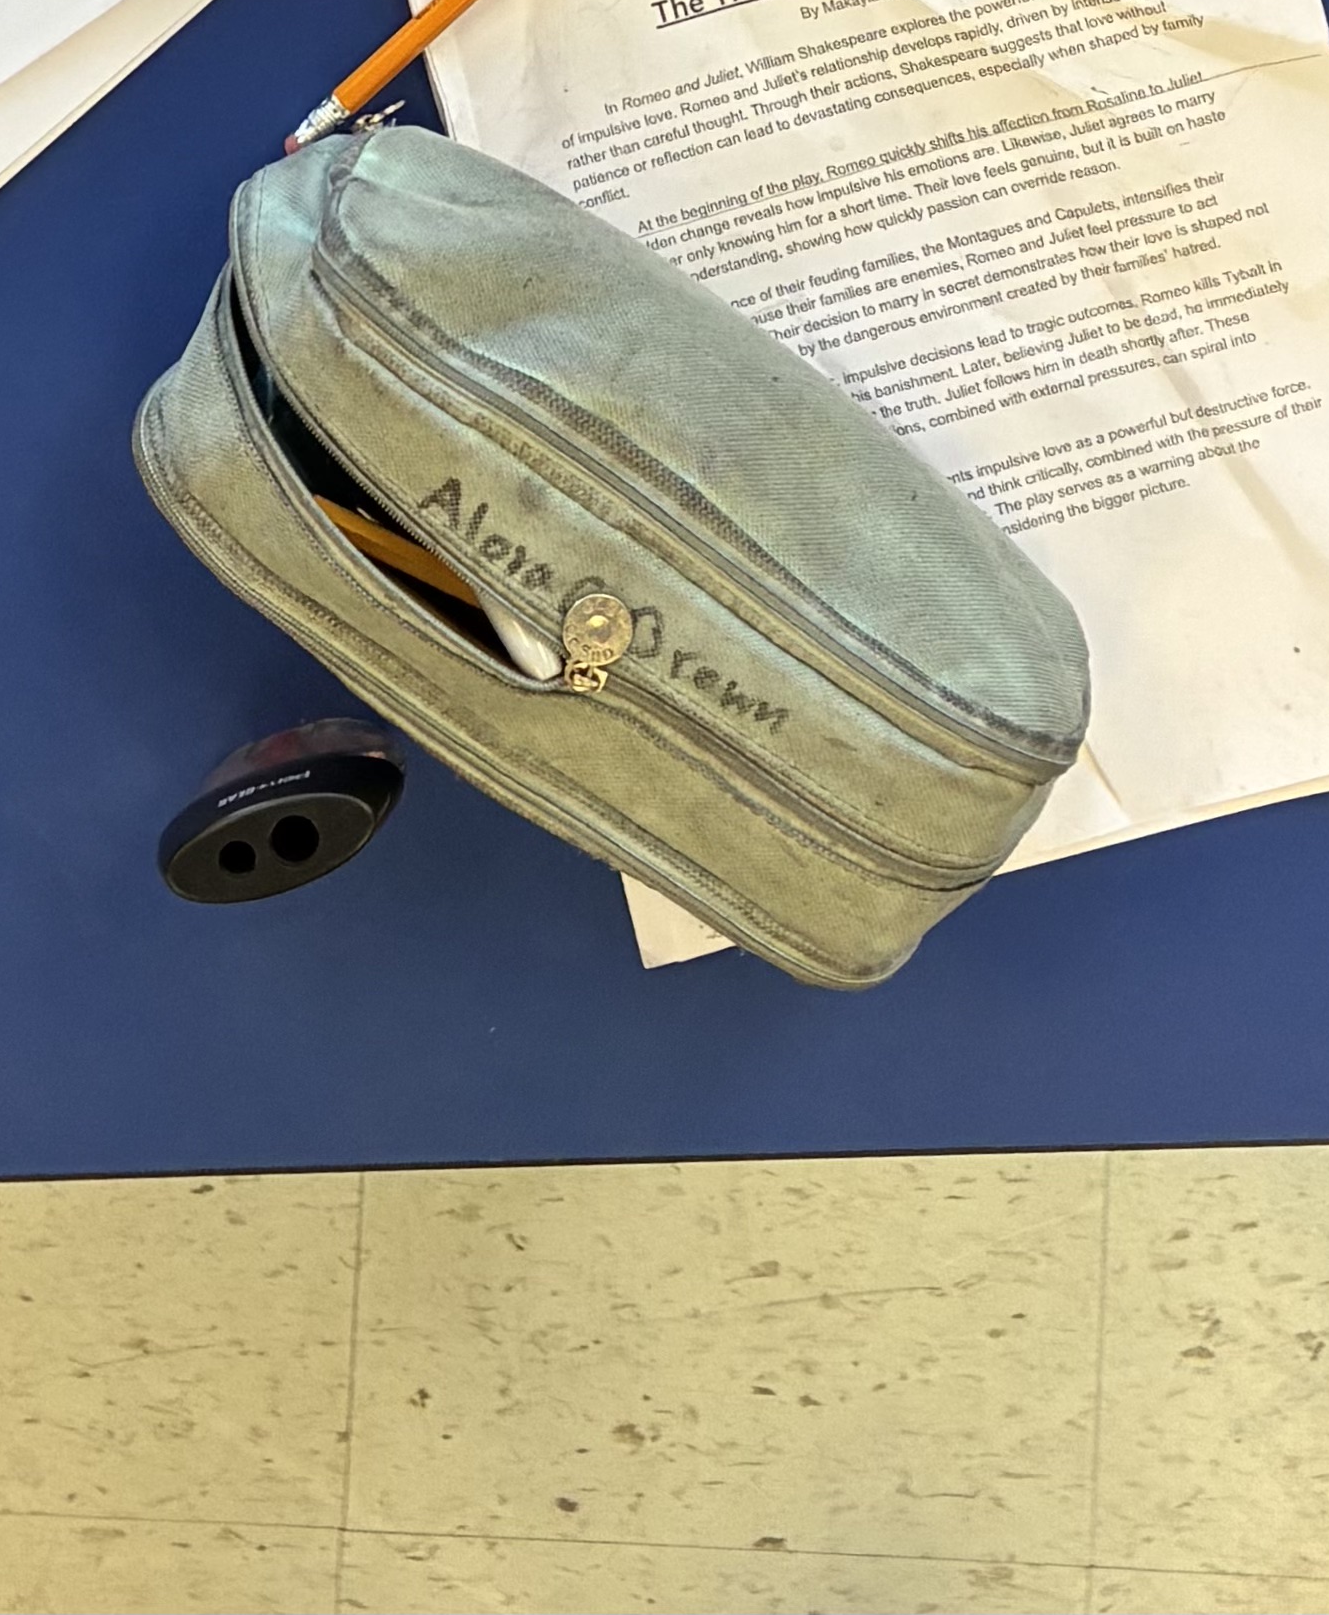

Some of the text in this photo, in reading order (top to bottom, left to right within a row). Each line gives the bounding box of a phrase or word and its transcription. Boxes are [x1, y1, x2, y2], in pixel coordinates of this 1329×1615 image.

[799, 6, 818, 19] By
[621, 88, 671, 110] Romeo
[674, 76, 700, 96] and
[703, 65, 743, 87] Juliet,
[744, 52, 795, 73] William
[797, 28, 887, 59] Shakespeare
[890, 14, 947, 35] explores
[948, 8, 971, 22] the
